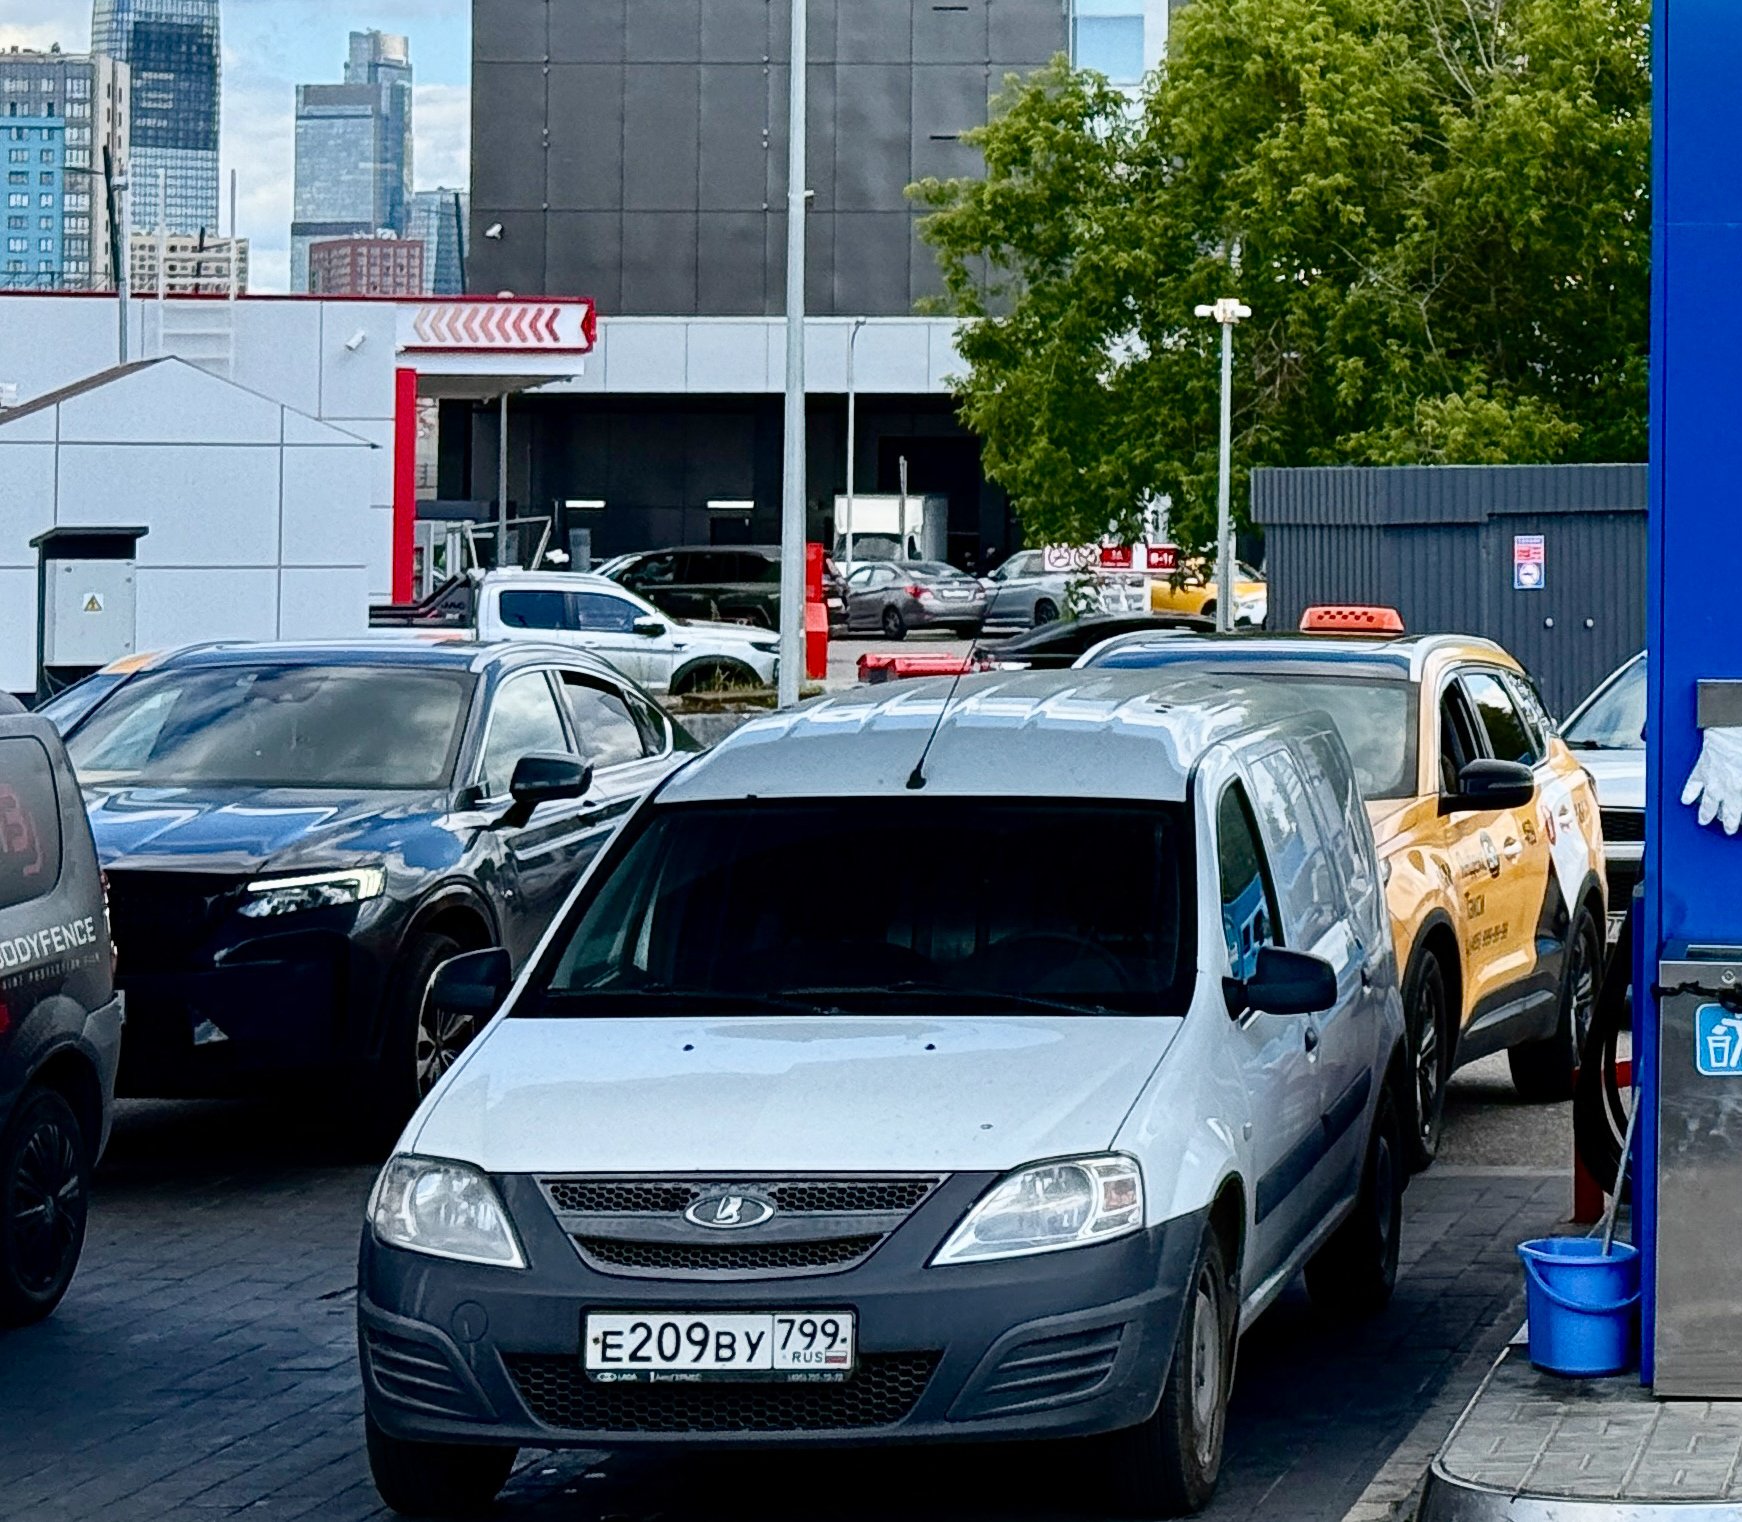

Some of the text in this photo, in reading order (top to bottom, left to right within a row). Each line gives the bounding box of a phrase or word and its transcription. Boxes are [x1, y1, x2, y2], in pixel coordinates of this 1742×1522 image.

[600, 1318, 841, 1363] Е209ВУ 799
[791, 1351, 824, 1364] RUS
